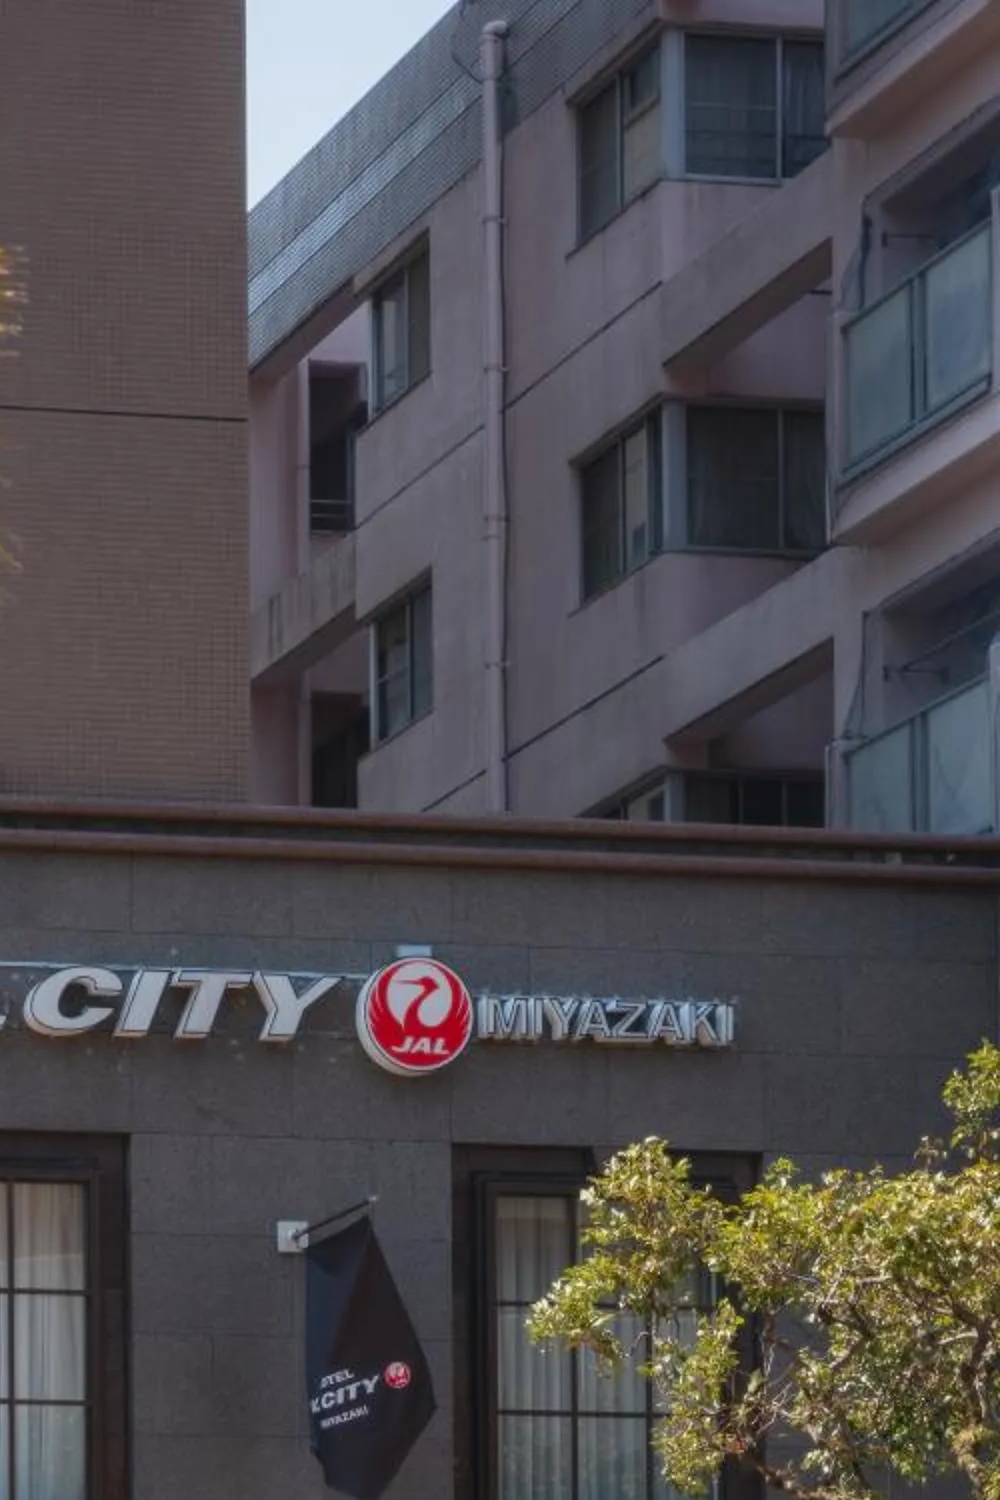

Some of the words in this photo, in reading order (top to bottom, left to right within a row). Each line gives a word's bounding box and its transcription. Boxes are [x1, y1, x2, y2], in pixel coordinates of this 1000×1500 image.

[23, 965, 344, 1041] CITY
[477, 993, 735, 1046] MIYAZAKI
[391, 1036, 450, 1055] JAL
